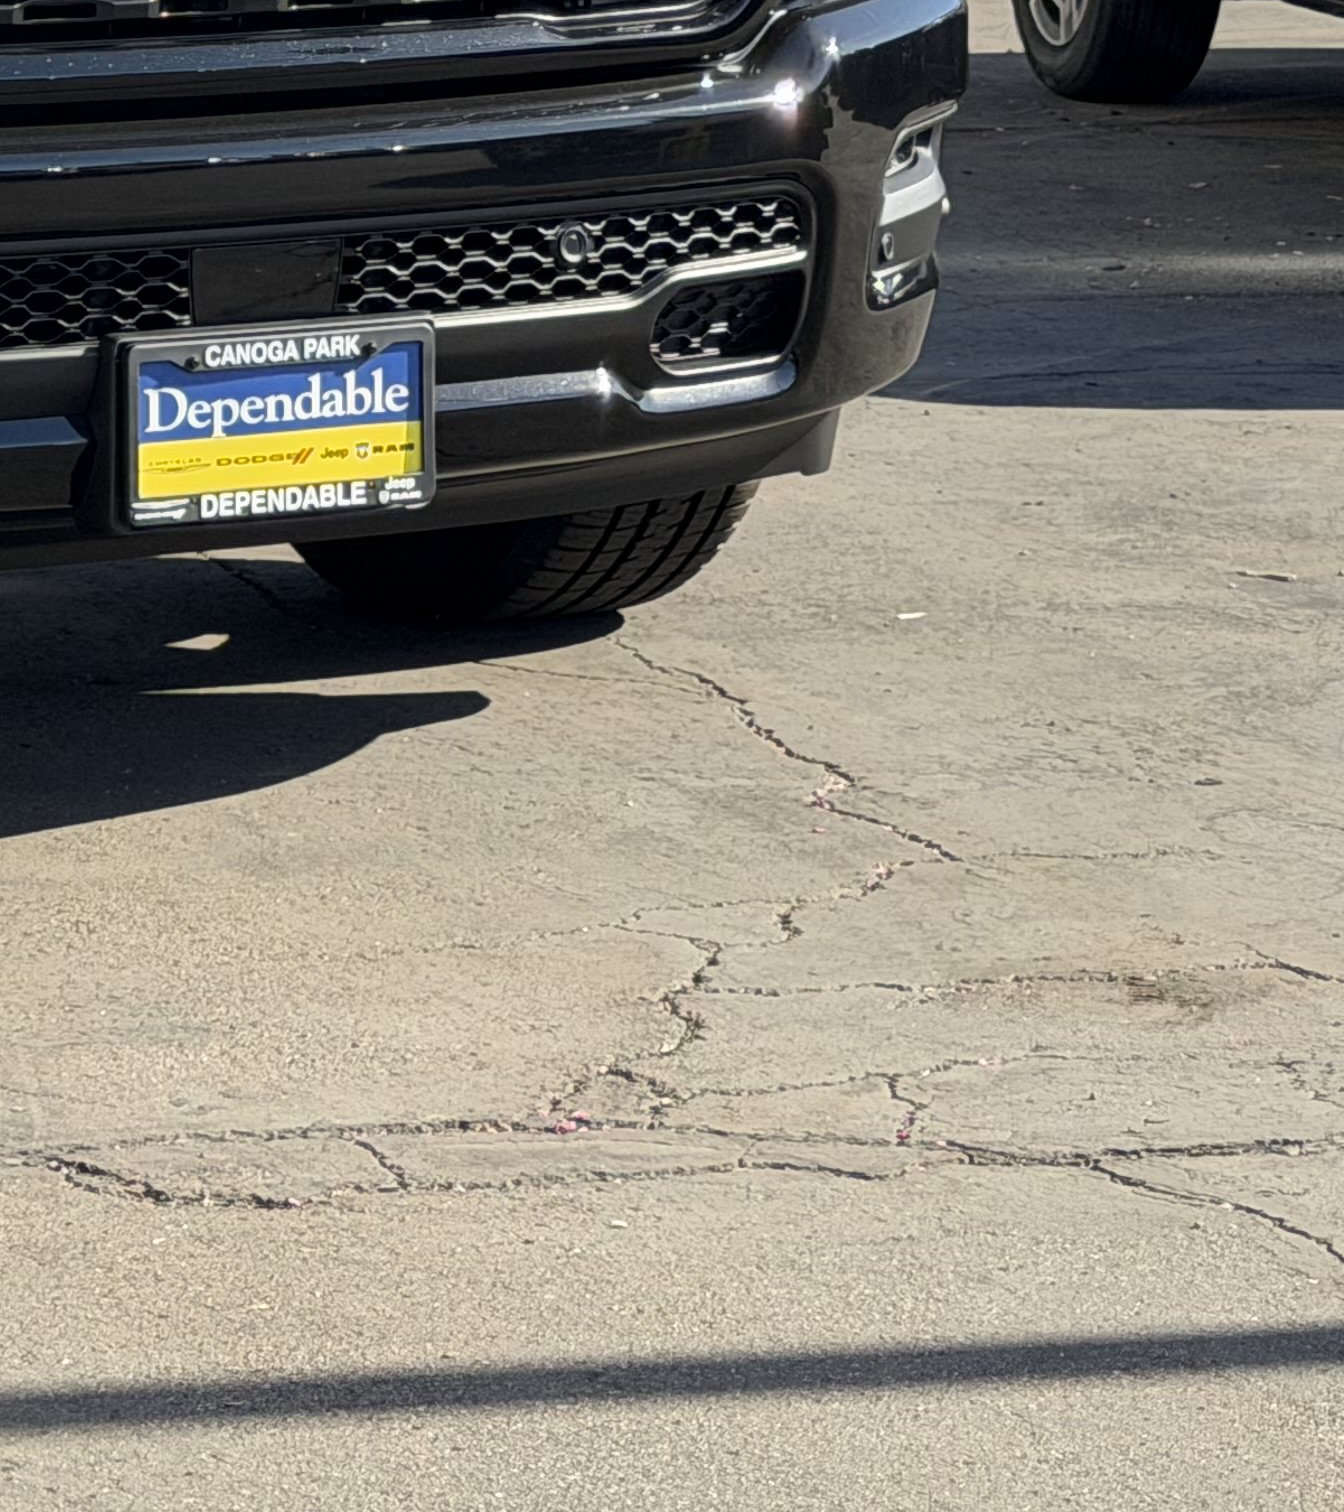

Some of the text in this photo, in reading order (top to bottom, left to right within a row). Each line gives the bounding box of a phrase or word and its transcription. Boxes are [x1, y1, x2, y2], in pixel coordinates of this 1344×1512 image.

[205, 334, 361, 368] CANOGA PARK
[142, 367, 410, 439] Dependable
[320, 447, 349, 460] Jeep
[200, 481, 367, 519] DEPENDABLE
